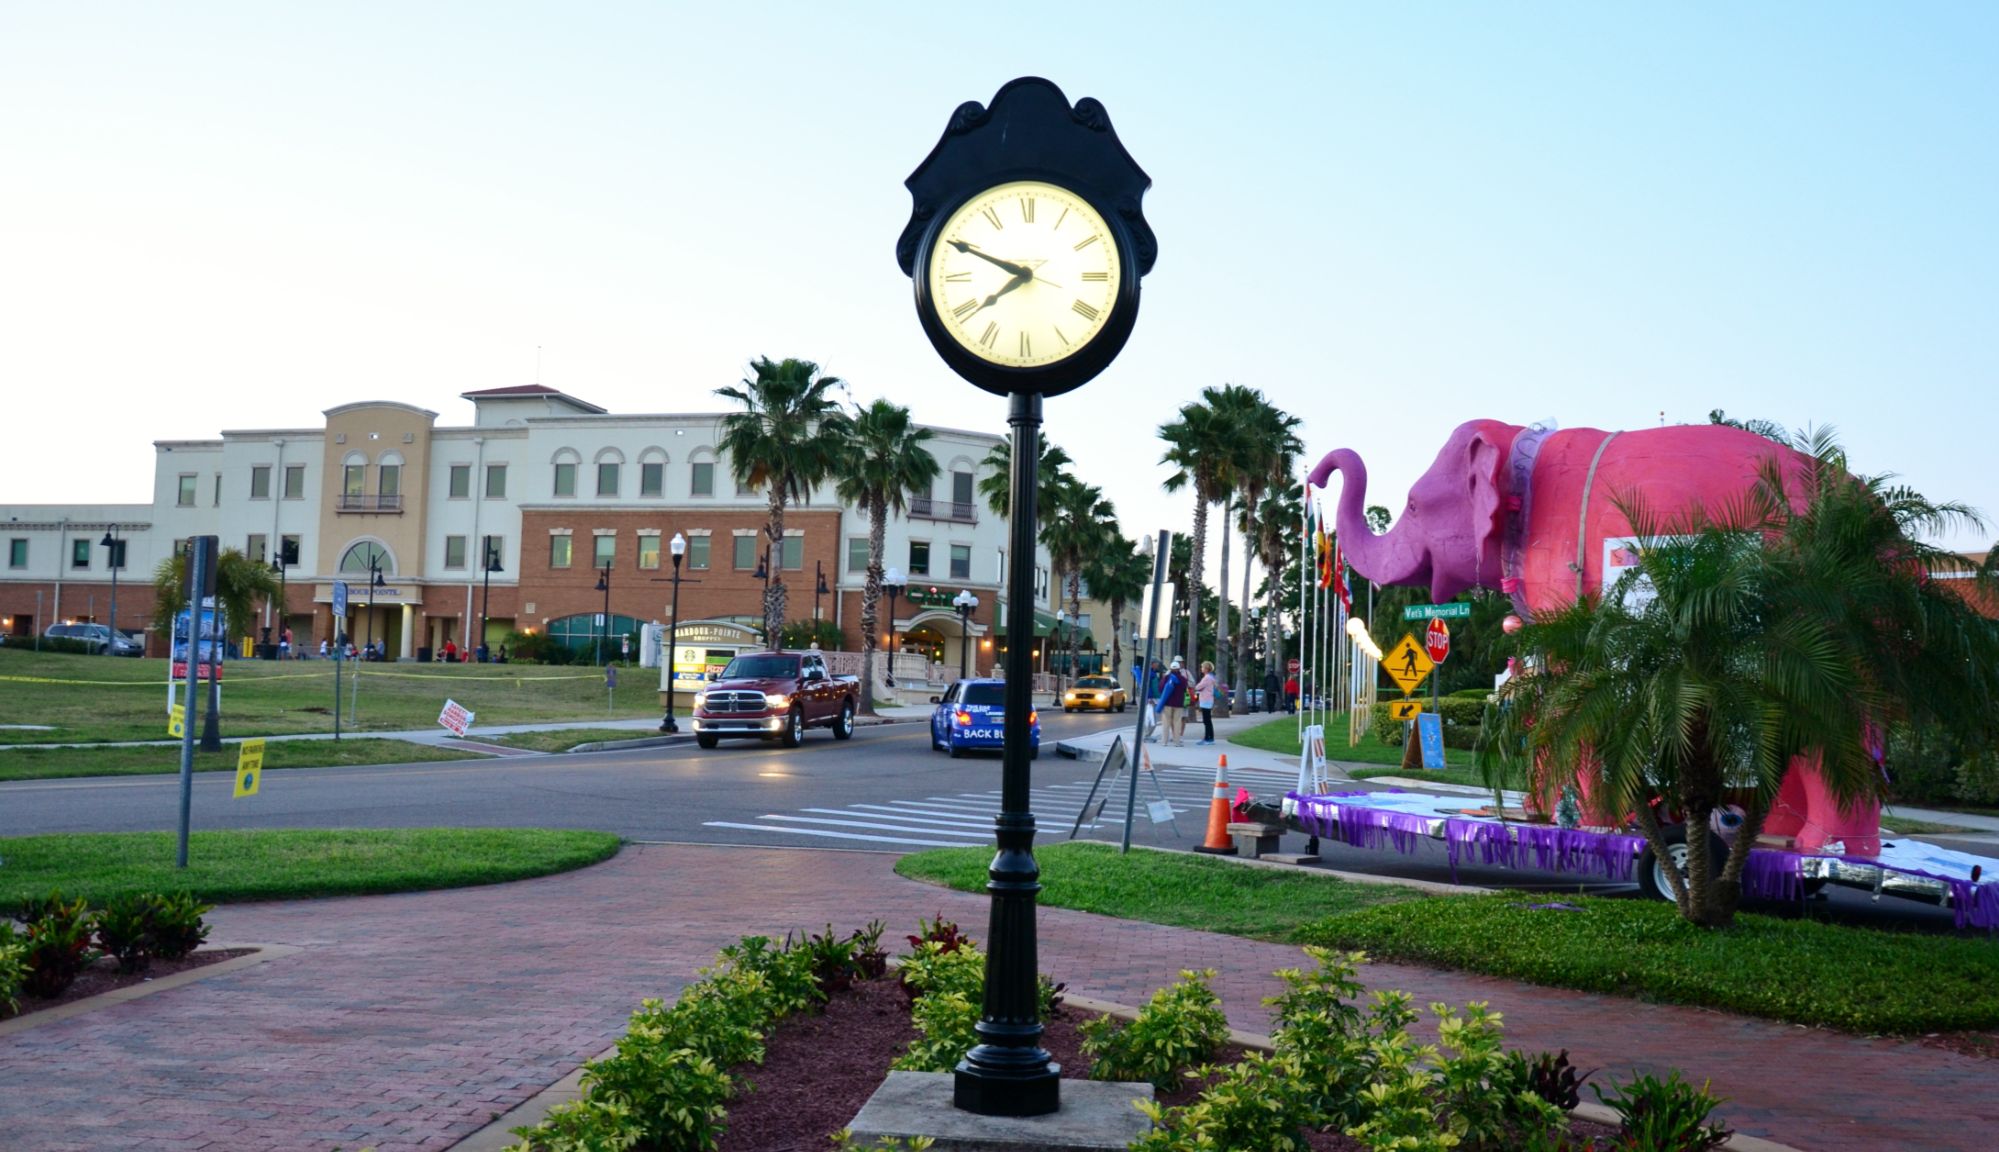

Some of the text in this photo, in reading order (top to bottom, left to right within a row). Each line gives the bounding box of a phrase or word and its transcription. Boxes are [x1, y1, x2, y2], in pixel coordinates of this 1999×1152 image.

[1405, 605, 1470, 618] Vet's Memorial Ln
[1428, 630, 1449, 650] STOP
[963, 729, 992, 739] BACK
